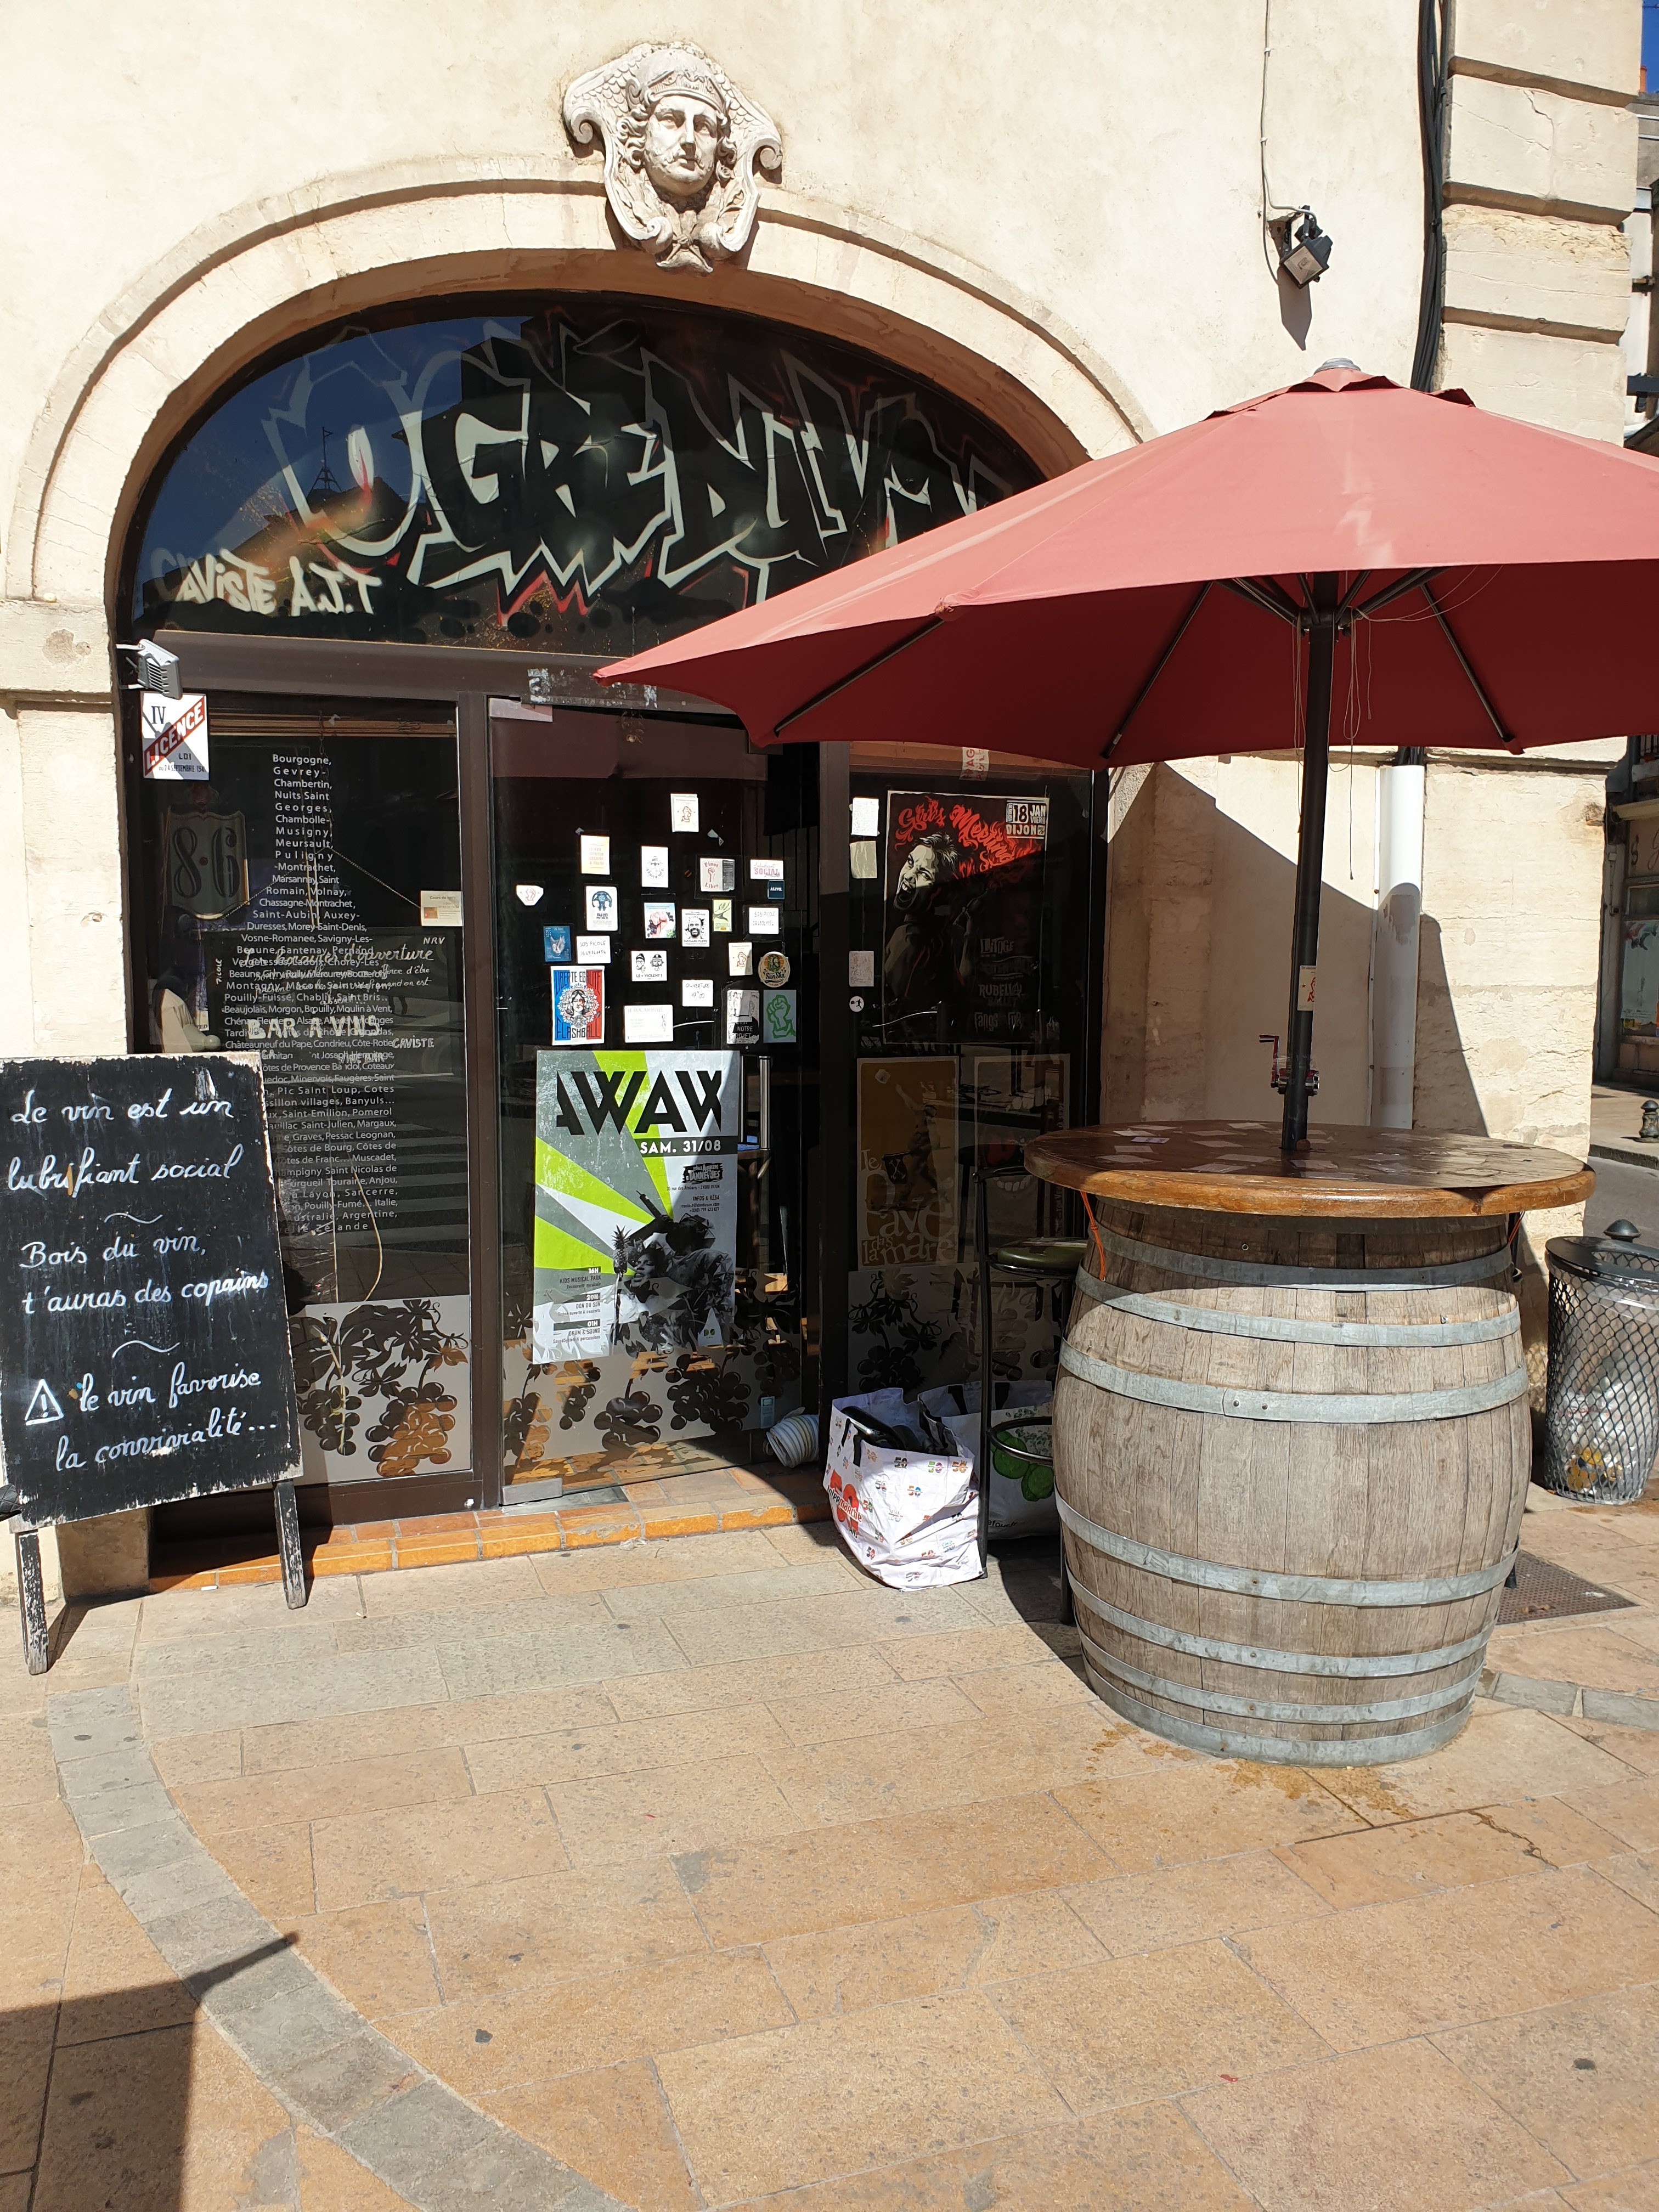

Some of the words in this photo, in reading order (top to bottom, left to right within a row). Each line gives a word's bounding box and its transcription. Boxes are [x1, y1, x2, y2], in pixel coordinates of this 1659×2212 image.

[151, 706, 166, 725] IV
[146, 701, 204, 770] LICENCE
[273, 754, 331, 766] Bourgogne,
[273, 766, 326, 778] Gevrey-
[274, 778, 332, 789] Chambertin,
[275, 791, 301, 799] Nuits
[304, 792, 329, 800] Saint
[275, 803, 332, 814] Georges,
[1014, 805, 1028, 822] 18
[1030, 805, 1046, 817] JAN
[275, 815, 330, 823] Chambolle-
[276, 827, 332, 838] Musigny,
[1006, 824, 1037, 835] DIJON
[276, 838, 333, 849] Meursault,
[275, 850, 333, 861] Puligny
[274, 862, 336, 873] -Montrachet,
[754, 867, 780, 877] SOCIAL
[273, 874, 318, 885] Marsannay,
[319, 876, 339, 884] Saint
[266, 887, 307, 896] Romain,
[311, 888, 347, 897] Volnay,
[259, 898, 356, 909] Chassagne-Montrachet,
[252, 910, 320, 920] Saint-Aubin,
[324, 912, 360, 922] Auxey-
[247, 922, 287, 932] Duresses,
[288, 922, 367, 932] Morey-Saint-Denis,
[241, 934, 317, 944] Vosne-Romanee,
[318, 934, 373, 944] Savigny-Les-
[423, 936, 446, 945] NRV
[236, 946, 278, 955] Beaune,
[280, 946, 330, 956] Santenay,
[328, 957, 379, 968] Chorey-Les
[416, 977, 432, 986] est
[224, 993, 294, 1004] Pouilly-Fuissé,
[337, 993, 361, 1002] Saint
[224, 1005, 267, 1015] Beaujolais,
[268, 1005, 303, 1015] Morgon,
[304, 1005, 336, 1015] Brouilly,
[336, 1005, 364, 1013] Moulin
[366, 1005, 371, 1013] à
[373, 1005, 393, 1015] Vent,
[246, 1017, 299, 1040] BAR
[329, 1014, 381, 1037] VINS
[556, 1016, 600, 1040] FLASHBALL
[225, 1039, 278, 1049] Châteauneuf
[279, 1039, 290, 1048] du
[291, 1041, 313, 1049] Pape,
[313, 1039, 351, 1048] Condrieu,
[281, 1063, 292, 1071] de
[293, 1063, 330, 1071] Provence
[291, 1075, 334, 1085] Minervois,
[374, 1074, 395, 1082] Saint
[277, 1087, 295, 1095] Pic
[298, 1086, 326, 1095] Saint
[331, 1085, 360, 1095] Loup,
[364, 1085, 395, 1093] Cotes
[10, 1089, 48, 1125] Le
[61, 1093, 115, 1122] vin
[127, 1088, 173, 1119] est
[179, 1099, 234, 1119] un
[301, 1097, 343, 1108] villages,
[345, 1096, 395, 1106] Banyuls...
[556, 1069, 722, 1136] AWAW
[281, 1108, 350, 1120] Saint-Emilion,
[352, 1107, 392, 1117] Pomerol
[301, 1120, 356, 1131] Saint-Julien,
[357, 1119, 397, 1129] Margaux,
[292, 1133, 325, 1143] Graves,
[325, 1132, 354, 1141] Pessac
[356, 1131, 396, 1141] Leognan,
[324, 1143, 355, 1153] Bourg,
[356, 1142, 383, 1150] Côtes
[385, 1142, 397, 1150] de
[640, 1140, 677, 1154] SAM.
[682, 1139, 722, 1153] 31/08
[302, 1155, 314, 1164] de
[352, 1153, 397, 1163] Muscadet,
[8, 1146, 140, 1199] lubrifiant
[150, 1143, 244, 1181] social
[325, 1166, 349, 1175] Saint
[351, 1165, 383, 1173] Nicolas
[369, 1176, 398, 1186] Anjou,
[375, 1198, 398, 1207] Italie,
[19, 1240, 88, 1268] Bois
[102, 1236, 139, 1261] du
[153, 1227, 207, 1256] vin,
[22, 1285, 127, 1314] t'auras
[134, 1278, 172, 1304] des
[180, 1268, 269, 1306] copains
[78, 1372, 99, 1413] le
[107, 1375, 156, 1406] vin
[168, 1362, 262, 1409] favorise
[55, 1435, 87, 1472] la
